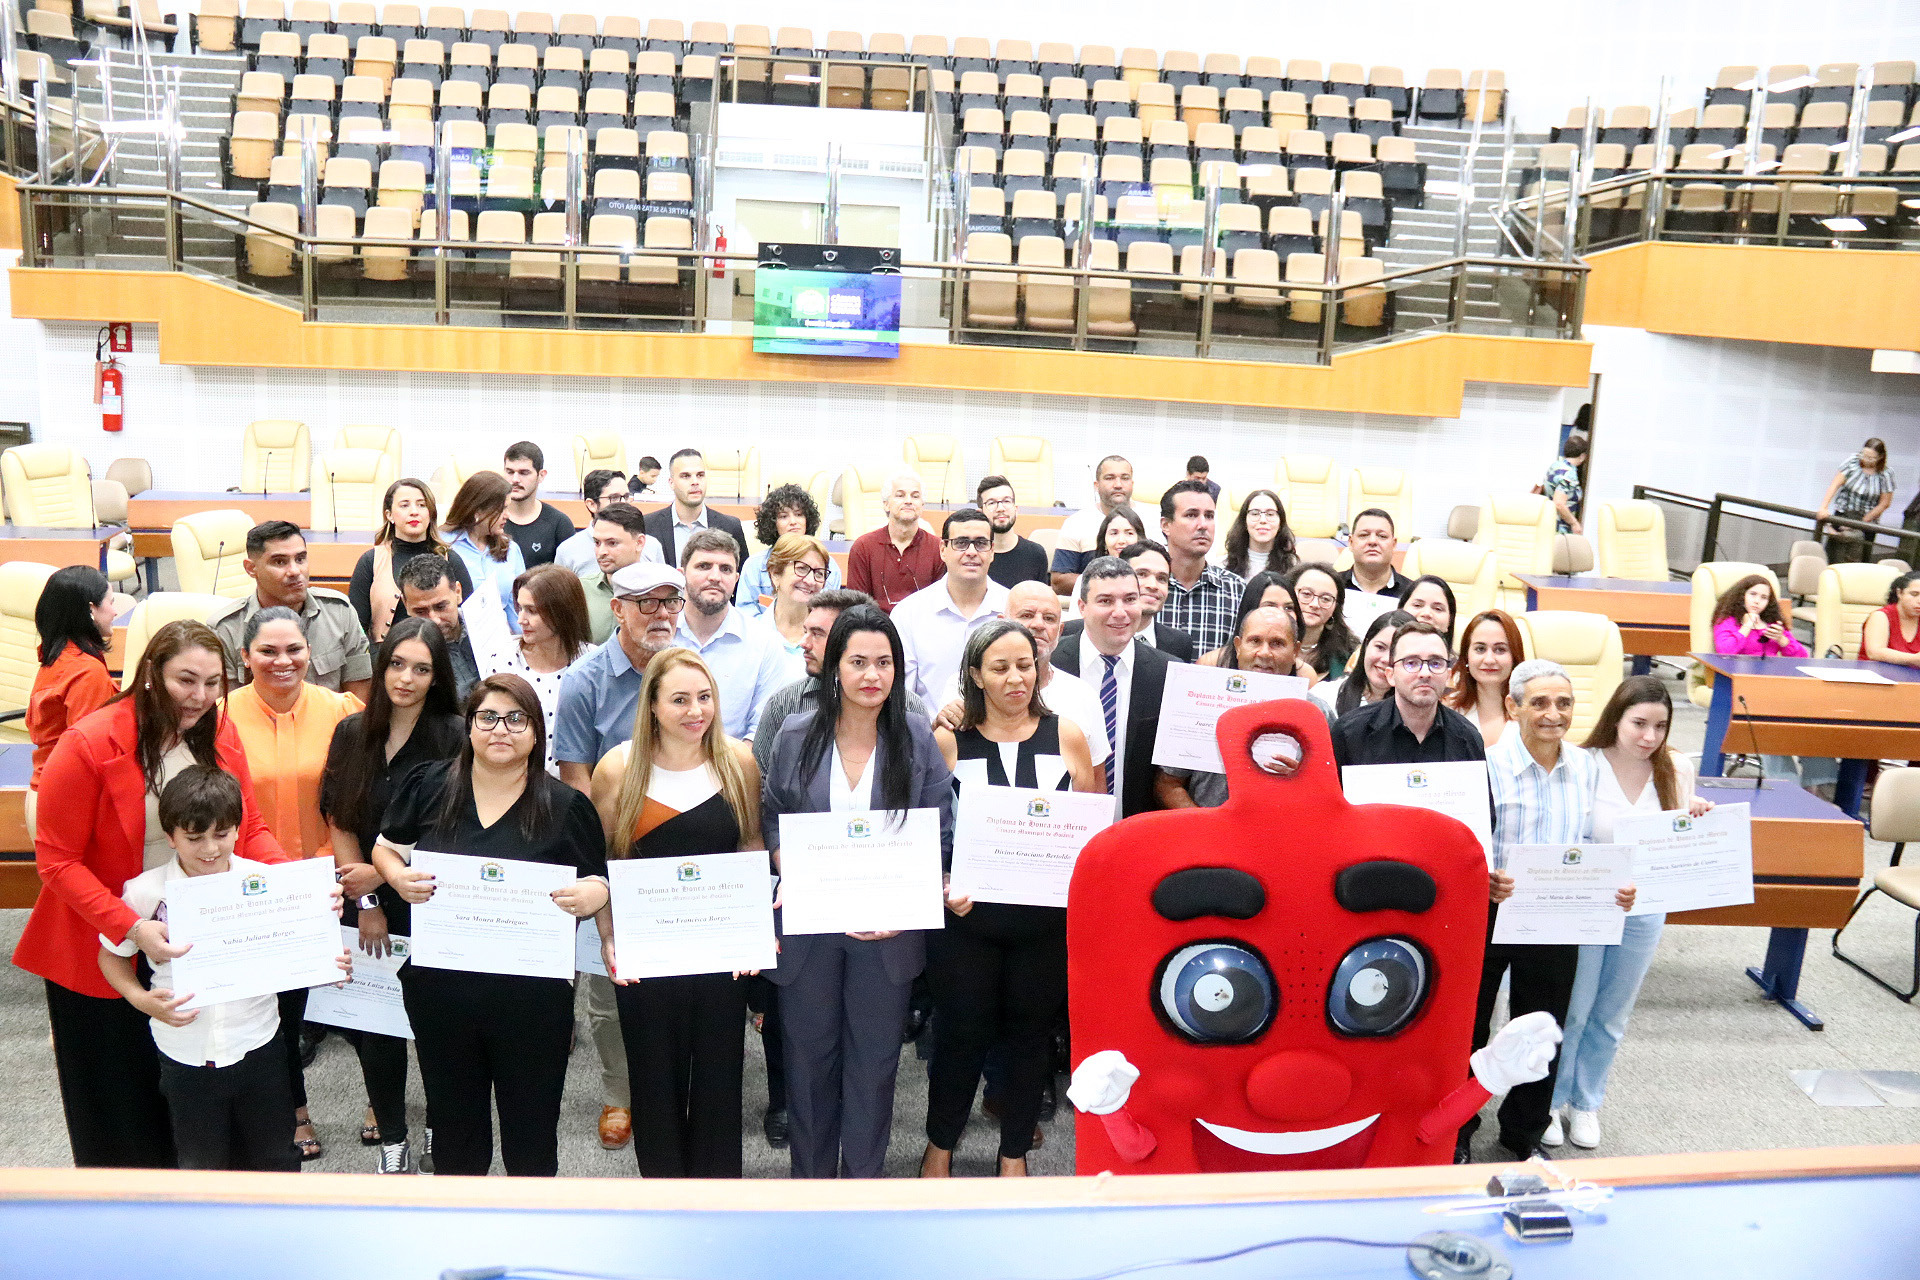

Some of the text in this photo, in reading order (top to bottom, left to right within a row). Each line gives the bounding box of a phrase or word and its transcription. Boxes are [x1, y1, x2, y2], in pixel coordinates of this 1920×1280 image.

[1187, 690, 1216, 700] Diploma
[1195, 720, 1214, 729] Juarez
[986, 817, 1017, 826] Diploma
[1018, 819, 1026, 827] de
[1029, 820, 1051, 829] Honra
[1064, 822, 1088, 831] Mérito
[1016, 850, 1044, 859] Graciano
[1045, 852, 1072, 860] Bertoldo
[437, 880, 469, 891] Diploma
[483, 884, 507, 894] Honra
[521, 887, 547, 897] Mérito
[638, 887, 669, 895] Diploma
[682, 884, 706, 893] Honra
[718, 882, 744, 890] Mérito
[199, 904, 234, 916] Diploma
[235, 901, 244, 910] de
[246, 898, 273, 908] Honra
[286, 892, 312, 902] Mérito
[472, 915, 494, 924] Moura
[495, 917, 529, 926] Rodrigues
[675, 916, 707, 924] Francisca
[244, 932, 271, 942] Juliana
[272, 930, 296, 939] Borges
[367, 981, 384, 990] Luiza
